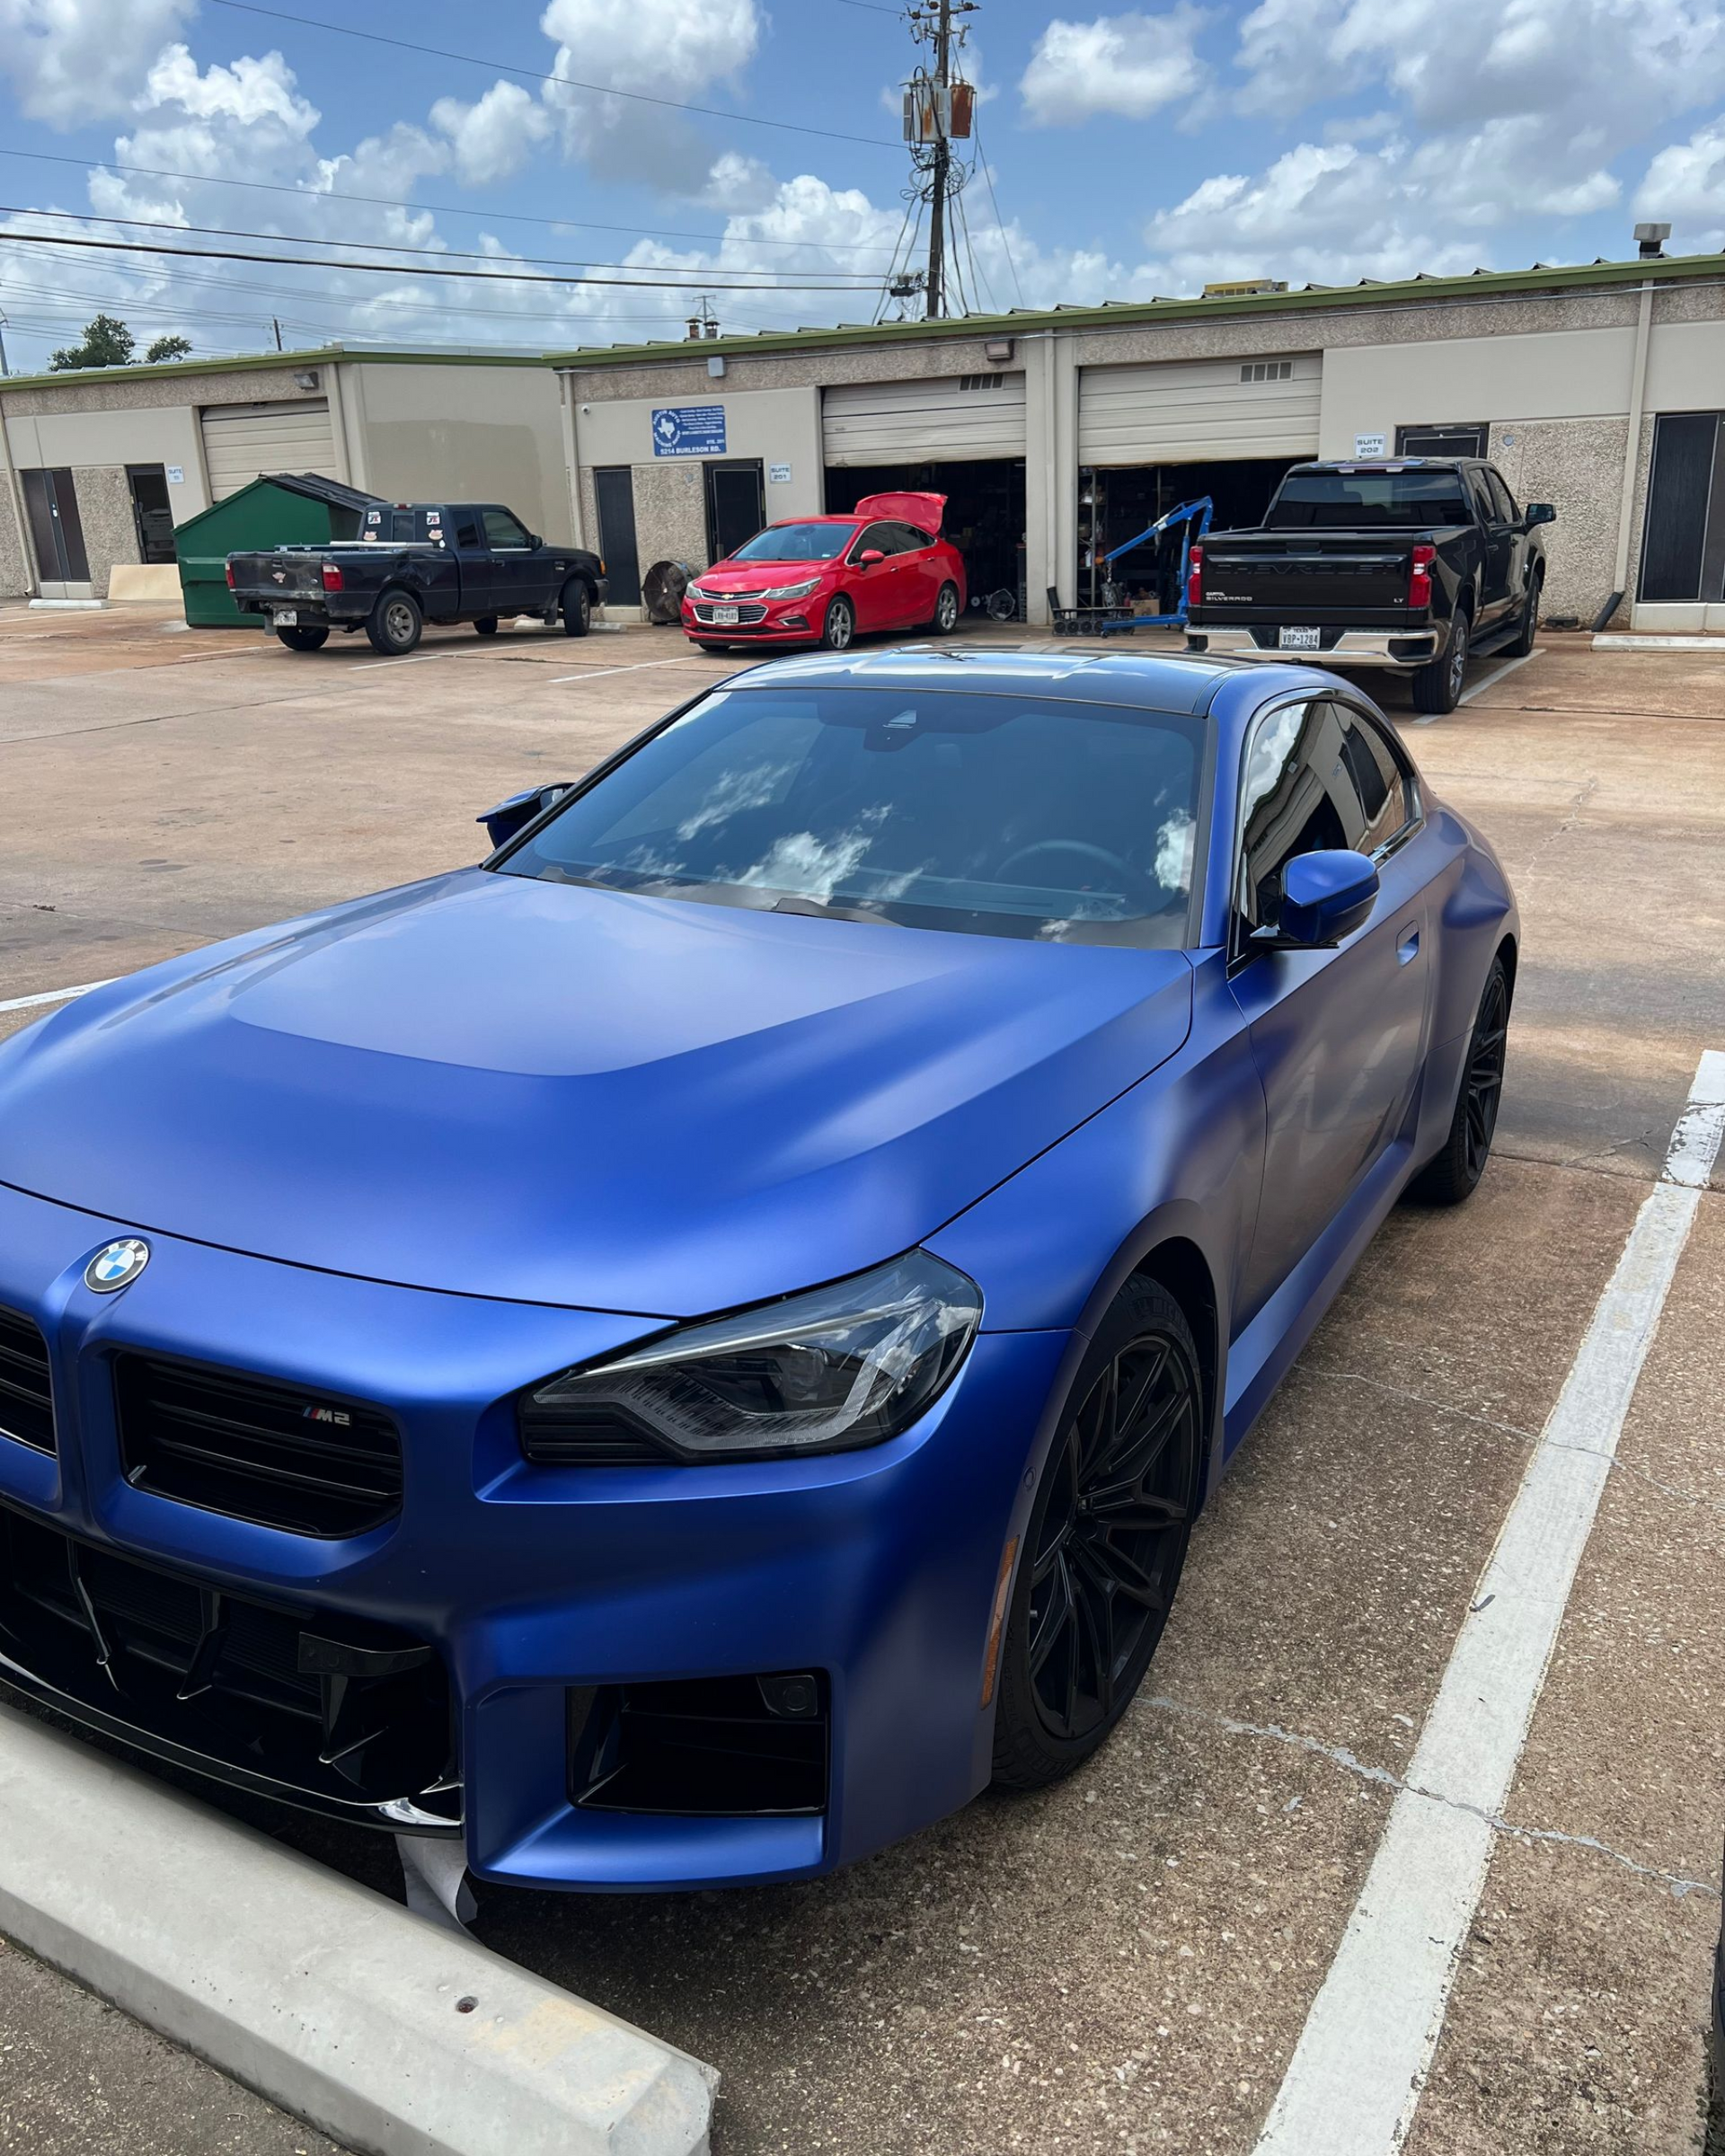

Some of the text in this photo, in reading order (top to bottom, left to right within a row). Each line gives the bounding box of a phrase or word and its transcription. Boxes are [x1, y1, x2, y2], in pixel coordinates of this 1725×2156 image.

[652, 410, 668, 425] AUSTIN
[668, 410, 681, 424] AUTO
[108, 1240, 147, 1261] BMW
[316, 1409, 350, 1426] M2
